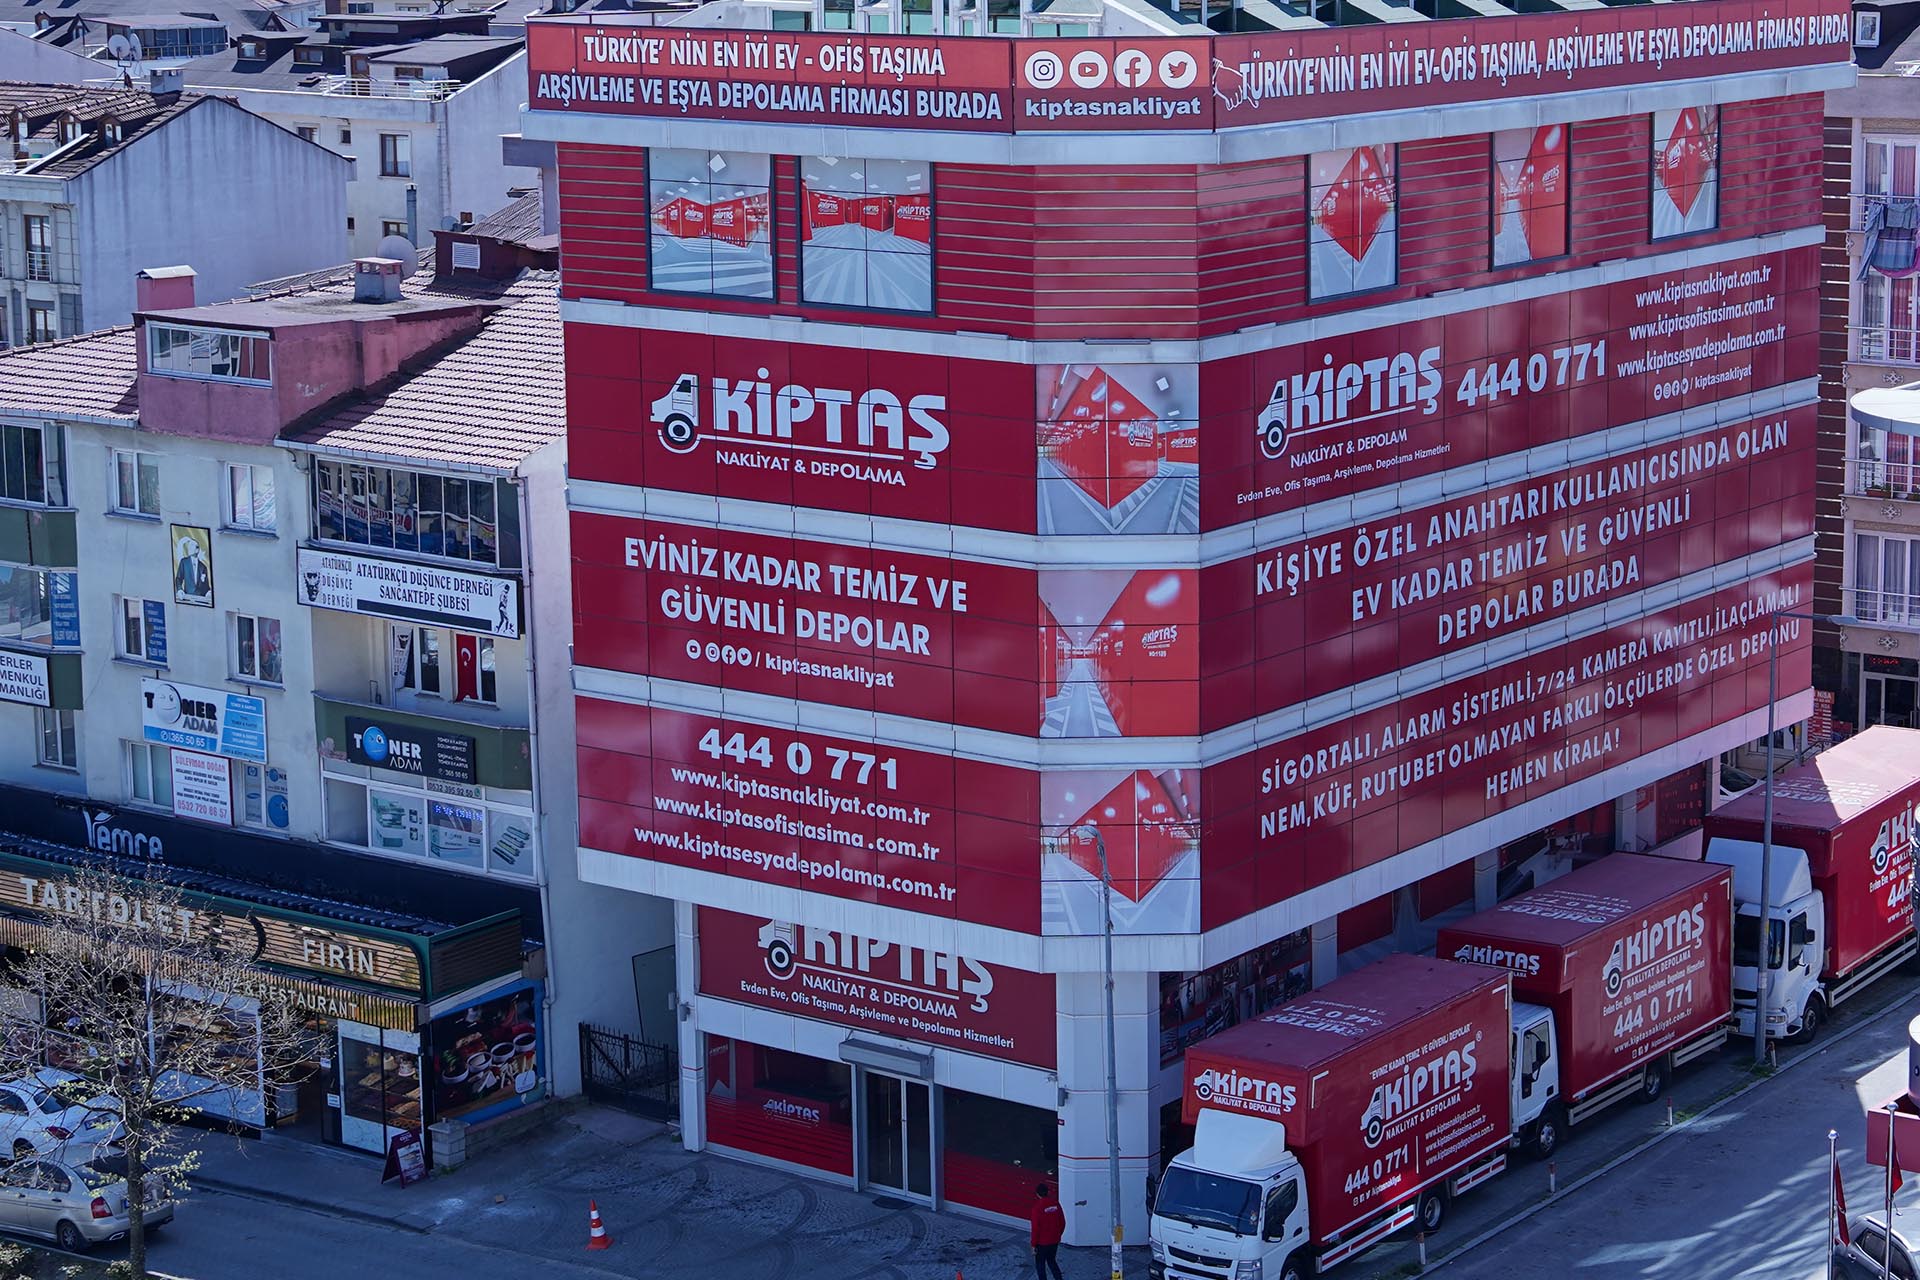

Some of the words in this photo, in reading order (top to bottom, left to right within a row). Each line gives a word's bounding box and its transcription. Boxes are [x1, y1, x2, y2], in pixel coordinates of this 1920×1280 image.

[584, 31, 664, 63] TÜRKİYE’
[671, 33, 706, 65] NİN
[714, 42, 738, 66] EN
[746, 35, 768, 68] İYİ
[776, 44, 799, 69] EV
[820, 39, 863, 72] OFİS
[870, 47, 945, 81] TAŞIMA
[1240, 45, 1354, 100] TÜRKİYE’NİN
[1361, 53, 1382, 89] EN
[1389, 40, 1408, 86] İYİ
[1415, 36, 1476, 84] EV-OFİS
[1481, 41, 1542, 85] TAŞIMA,
[1546, 27, 1623, 79] ARŞİVLEME
[1628, 31, 1644, 62] VE
[1649, 28, 1679, 69] EŞYA
[1684, 21, 1753, 57] DEPOLAMA
[1757, 11, 1805, 50] FİRMASI
[1809, 14, 1848, 45] BURDA
[538, 68, 634, 106] ARŞİVLEME
[639, 79, 662, 103] VE
[669, 80, 712, 112] EŞYA
[719, 82, 824, 112] DEPOLAMA
[831, 80, 908, 115] FİRMASI
[917, 91, 1002, 119] BURADA
[1025, 95, 1200, 118] kiptasnakliyat
[1636, 265, 1772, 308] www.kiptasnakliyat.com.tr
[1630, 295, 1775, 341] www.kiptasofistasima.com.tr
[1456, 360, 1520, 407] 444
[1526, 352, 1547, 393] 0
[1552, 340, 1606, 383] 771
[1617, 324, 1786, 378] www.kiptasesyadepolama.com.tr
[1291, 345, 1442, 425] KİPTAŞ
[713, 367, 951, 470] KİPTAŞ
[716, 449, 789, 471] NAKLİYAT
[794, 458, 806, 473] &
[811, 461, 906, 486] DEPOLAMA
[1237, 491, 1263, 504] Evden
[1284, 480, 1301, 492] Ofis
[1414, 442, 1450, 462] Hizmetleri
[1290, 442, 1344, 468] NAKLİYAT
[1346, 438, 1355, 454] &
[1257, 542, 1341, 595] KİŞİYE
[1354, 523, 1416, 566] ÖZEL
[1427, 486, 1546, 547] ANAHTARI
[1554, 437, 1730, 510] KULLANICISINDA
[1737, 420, 1787, 458] OLAN
[322, 555, 352, 575] ATATÜRKÇÜ
[625, 535, 717, 577] EVİNİZ
[724, 551, 821, 592] KADAR
[829, 565, 918, 605] TEMİZ
[926, 577, 966, 612] VE
[1353, 583, 1382, 621] EV
[1392, 558, 1472, 609] KADAR
[1479, 533, 1547, 581] TEMİZ
[1561, 524, 1586, 556] VE
[1599, 488, 1689, 545] GÜVENLİ
[322, 573, 353, 591] DÜŞÜNCE
[322, 593, 353, 609] DERNEĞİ
[356, 562, 408, 587] ATATÜRKÇÜ
[410, 568, 451, 590] DÜŞÜNCE
[453, 577, 494, 598] DERNEĞİ
[379, 584, 435, 606] SANCAKTEPE
[437, 593, 470, 612] ŞUBESİ
[1439, 585, 1543, 644] DEPOLAR
[1553, 555, 1639, 607] BURADA
[661, 585, 784, 635] GÜVENLİ
[796, 608, 930, 655] DEPOLAR
[765, 652, 894, 690] kiptasnakliyat
[1582, 638, 1648, 679] KAMERA
[182, 716, 218, 735] ADAM
[1362, 749, 1445, 801] RUTUBET
[1449, 716, 1535, 767] OLMAYAN
[1544, 692, 1598, 732] FARKLI
[1605, 658, 1692, 708] ÖLÇÜLERDE
[1698, 644, 1734, 674] ÖZEL
[389, 757, 423, 772] ADAM
[699, 728, 773, 768] 444
[786, 742, 811, 773] 0
[825, 748, 898, 789] 771
[1487, 756, 1546, 799] HEMEN
[1554, 728, 1619, 773] KİRALA!
[671, 767, 930, 825] www.kiptasnakliyat.com.tr
[84, 810, 163, 859] Yemre
[634, 826, 956, 901] www.kiptasesyadepolama.com.tr
[1473, 945, 1540, 975] KİPTAŞ
[1627, 902, 1705, 970] KİPTAŞ
[1626, 965, 1655, 989] NAKLİYAT
[1661, 950, 1691, 973] DEPOLAMA
[258, 984, 358, 1020] RESTAURANT
[741, 981, 768, 996] Evden
[770, 987, 789, 1002] Eve,
[791, 991, 810, 1005] Ofis
[812, 996, 847, 1014] Taşıma,
[849, 1004, 895, 1024] Arşivleme
[898, 1017, 909, 1026] ve
[912, 1016, 960, 1038] Depolama
[963, 1029, 1014, 1049] Hizmetleri
[802, 973, 866, 999] NAKLİYAT
[870, 991, 879, 1002] &
[884, 992, 957, 1018] DEPOLAMA
[1613, 1004, 1643, 1038] 444
[1650, 996, 1659, 1020] 0
[1665, 979, 1692, 1012] 771
[1614, 1008, 1692, 1054] www.kiptasnakliyat.com.tr
[1214, 1070, 1296, 1112] KİPTAŞ
[1385, 1041, 1477, 1120] KİPTAŞ
[1386, 1114, 1419, 1140] NAKLİYAT
[1426, 1093, 1461, 1119] DEPOLAMA
[1344, 1165, 1369, 1194] 444
[1373, 1159, 1382, 1179] 0
[1386, 1144, 1408, 1173] 771
